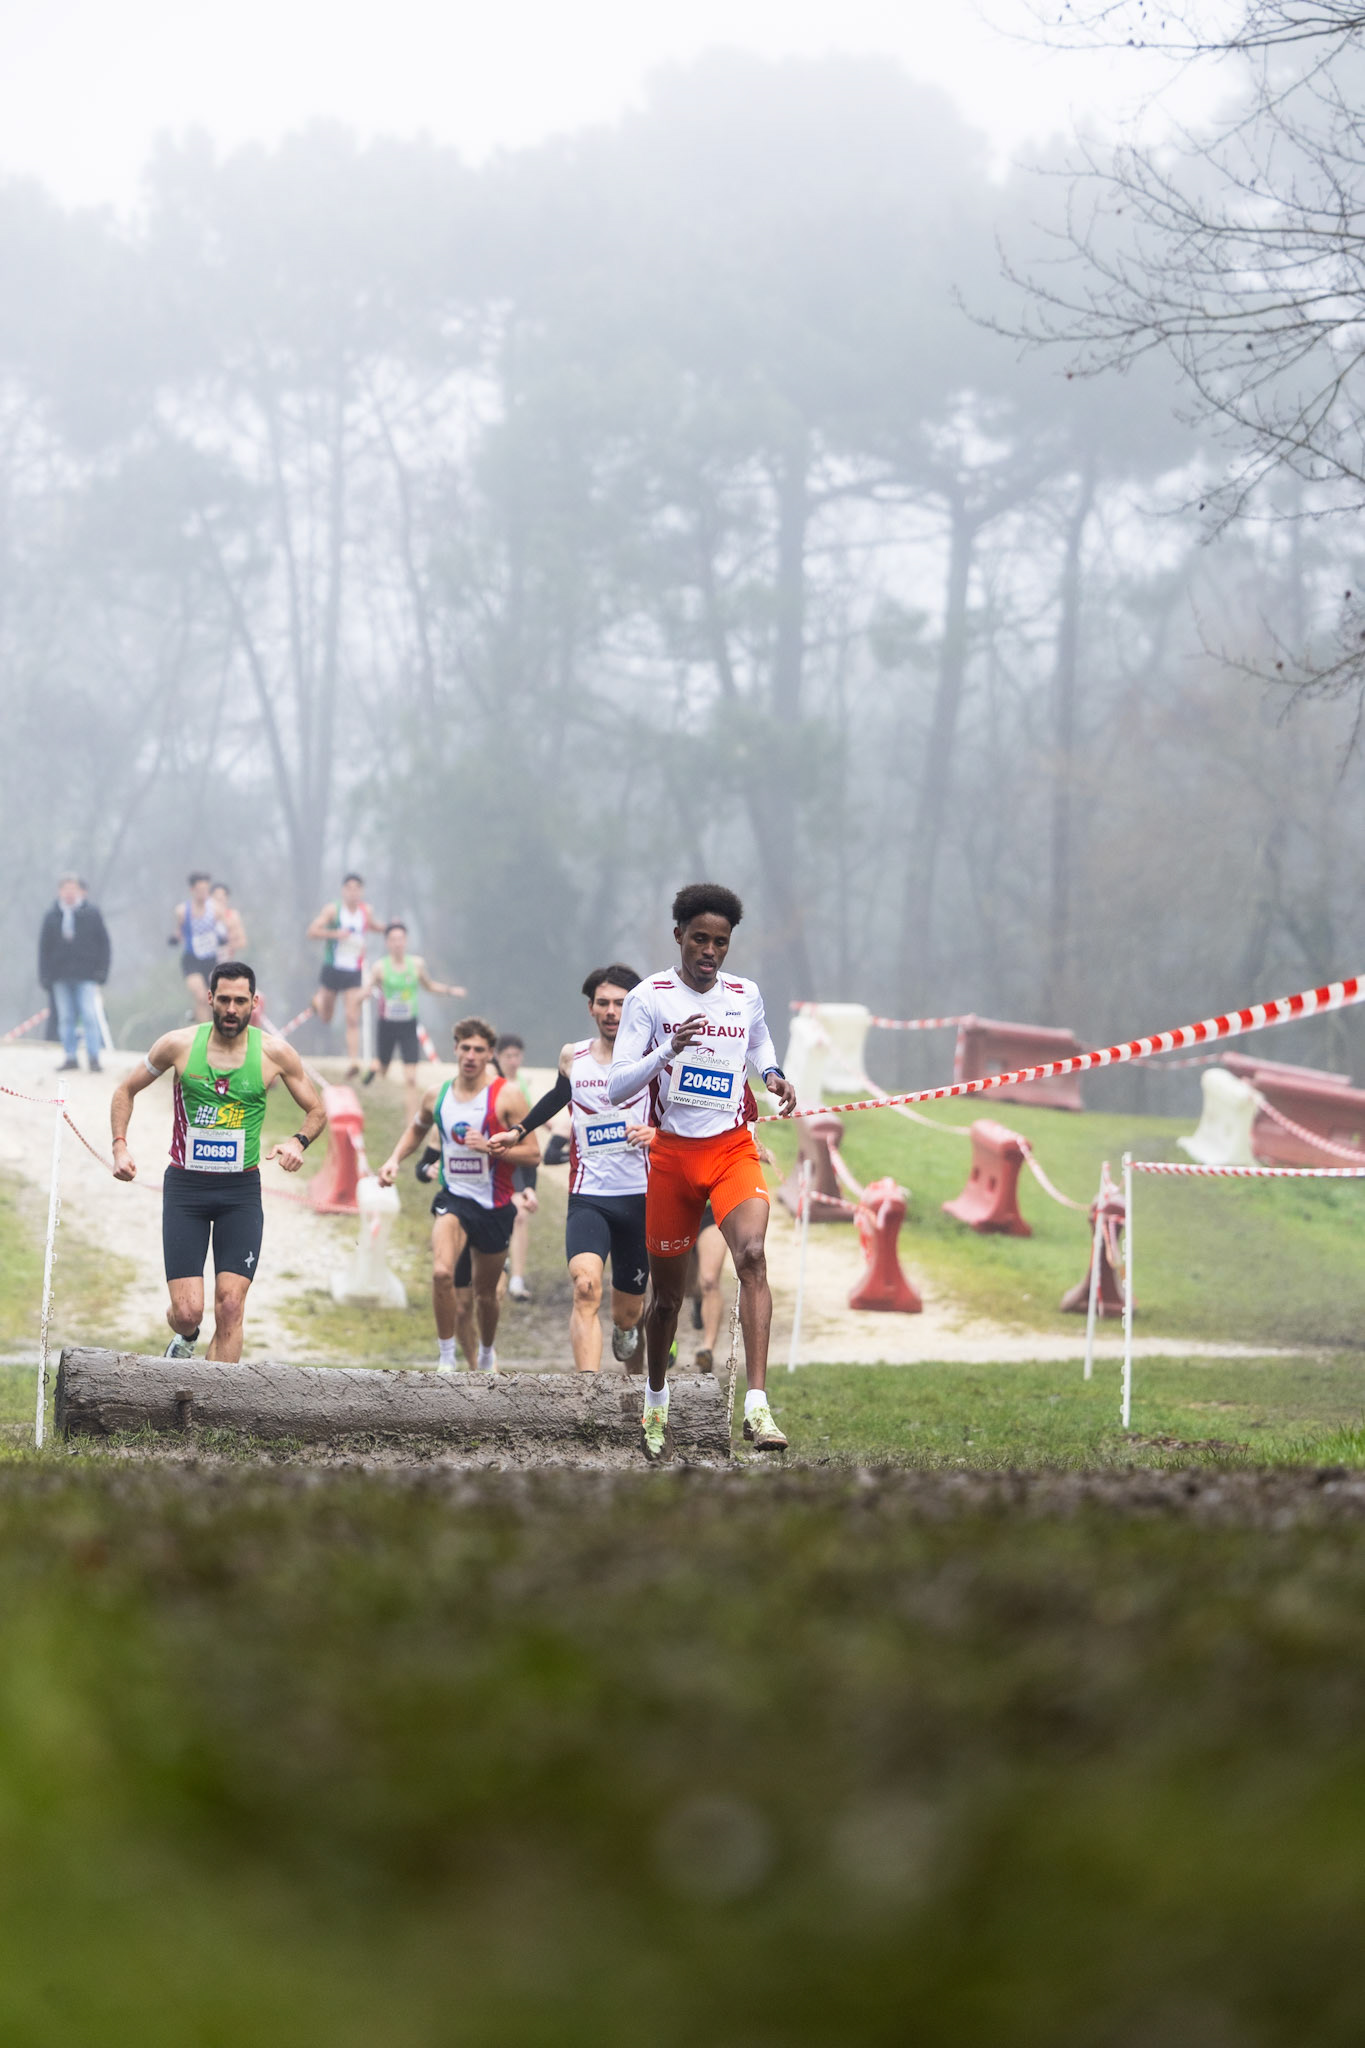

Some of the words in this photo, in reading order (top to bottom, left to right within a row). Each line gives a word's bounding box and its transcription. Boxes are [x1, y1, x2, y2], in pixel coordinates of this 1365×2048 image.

[662, 1023, 745, 1039] BODEAUX
[691, 1054, 730, 1067] PROTIMING
[575, 1080, 608, 1088] BORD
[683, 1071, 730, 1093] 20455
[673, 1095, 733, 1110] www.protiming.fr
[588, 1126, 625, 1142] 20456
[195, 1143, 235, 1158] 20689
